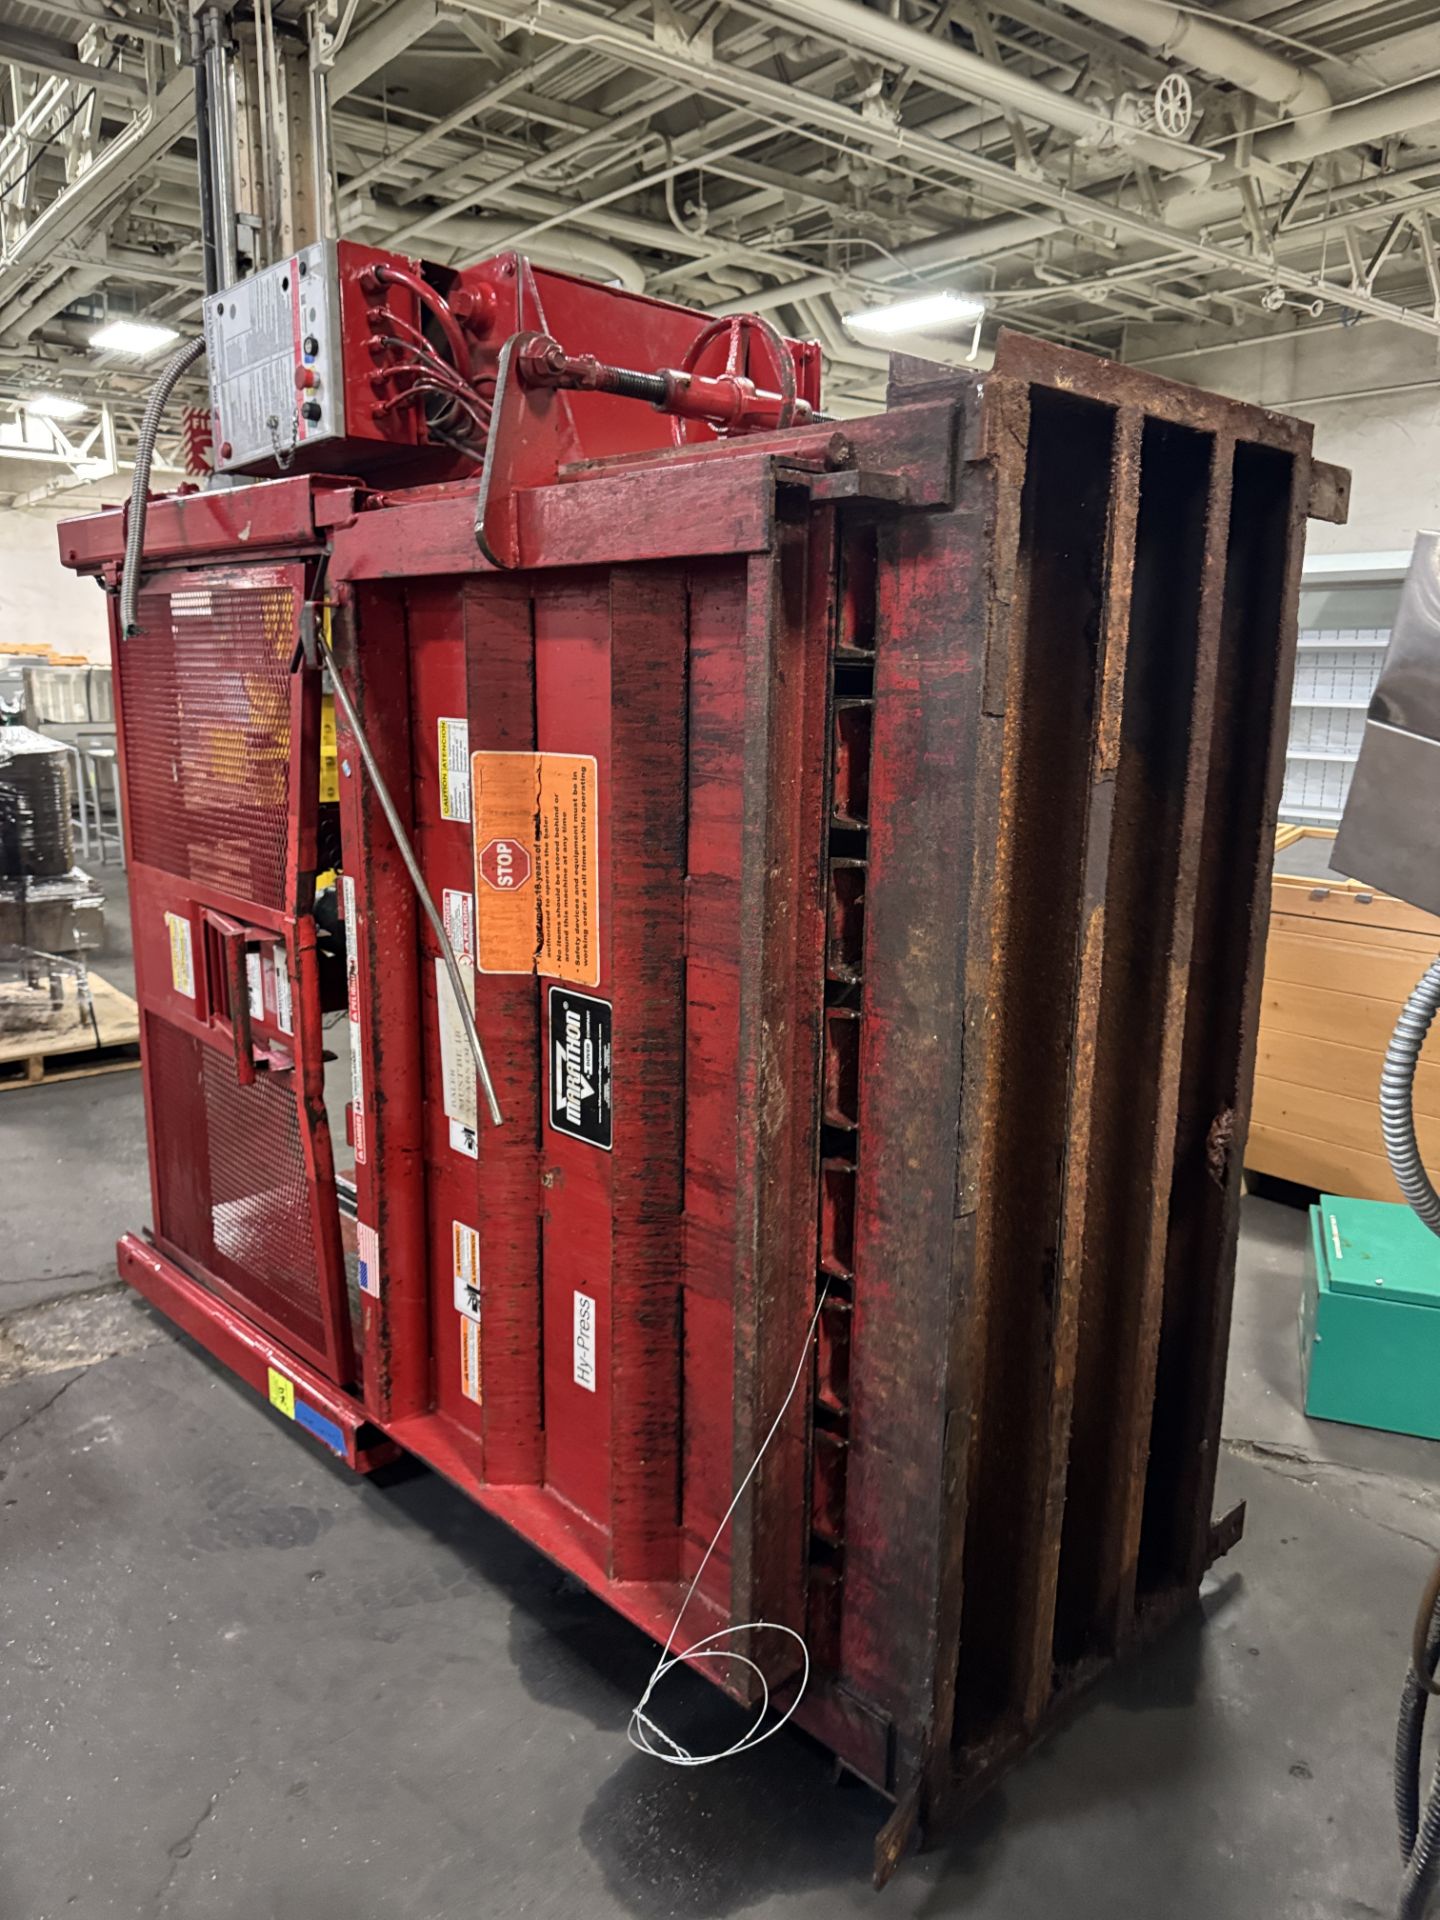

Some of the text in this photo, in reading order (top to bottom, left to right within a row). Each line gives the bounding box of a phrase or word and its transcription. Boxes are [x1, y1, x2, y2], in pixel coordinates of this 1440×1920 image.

[572, 772, 577, 780] in
[573, 784, 577, 795] be
[554, 793, 559, 803] or
[534, 844, 541, 853] of
[496, 843, 513, 886] STOP
[563, 856, 567, 865] at
[555, 874, 560, 885] be
[535, 885, 541, 894] 18
[582, 889, 587, 898] at
[545, 898, 550, 907] to
[557, 950, 561, 961] No
[566, 1010, 581, 1125] MARATHON
[355, 1116, 363, 1149] DANGER
[576, 1298, 593, 1384] Hy-Press
